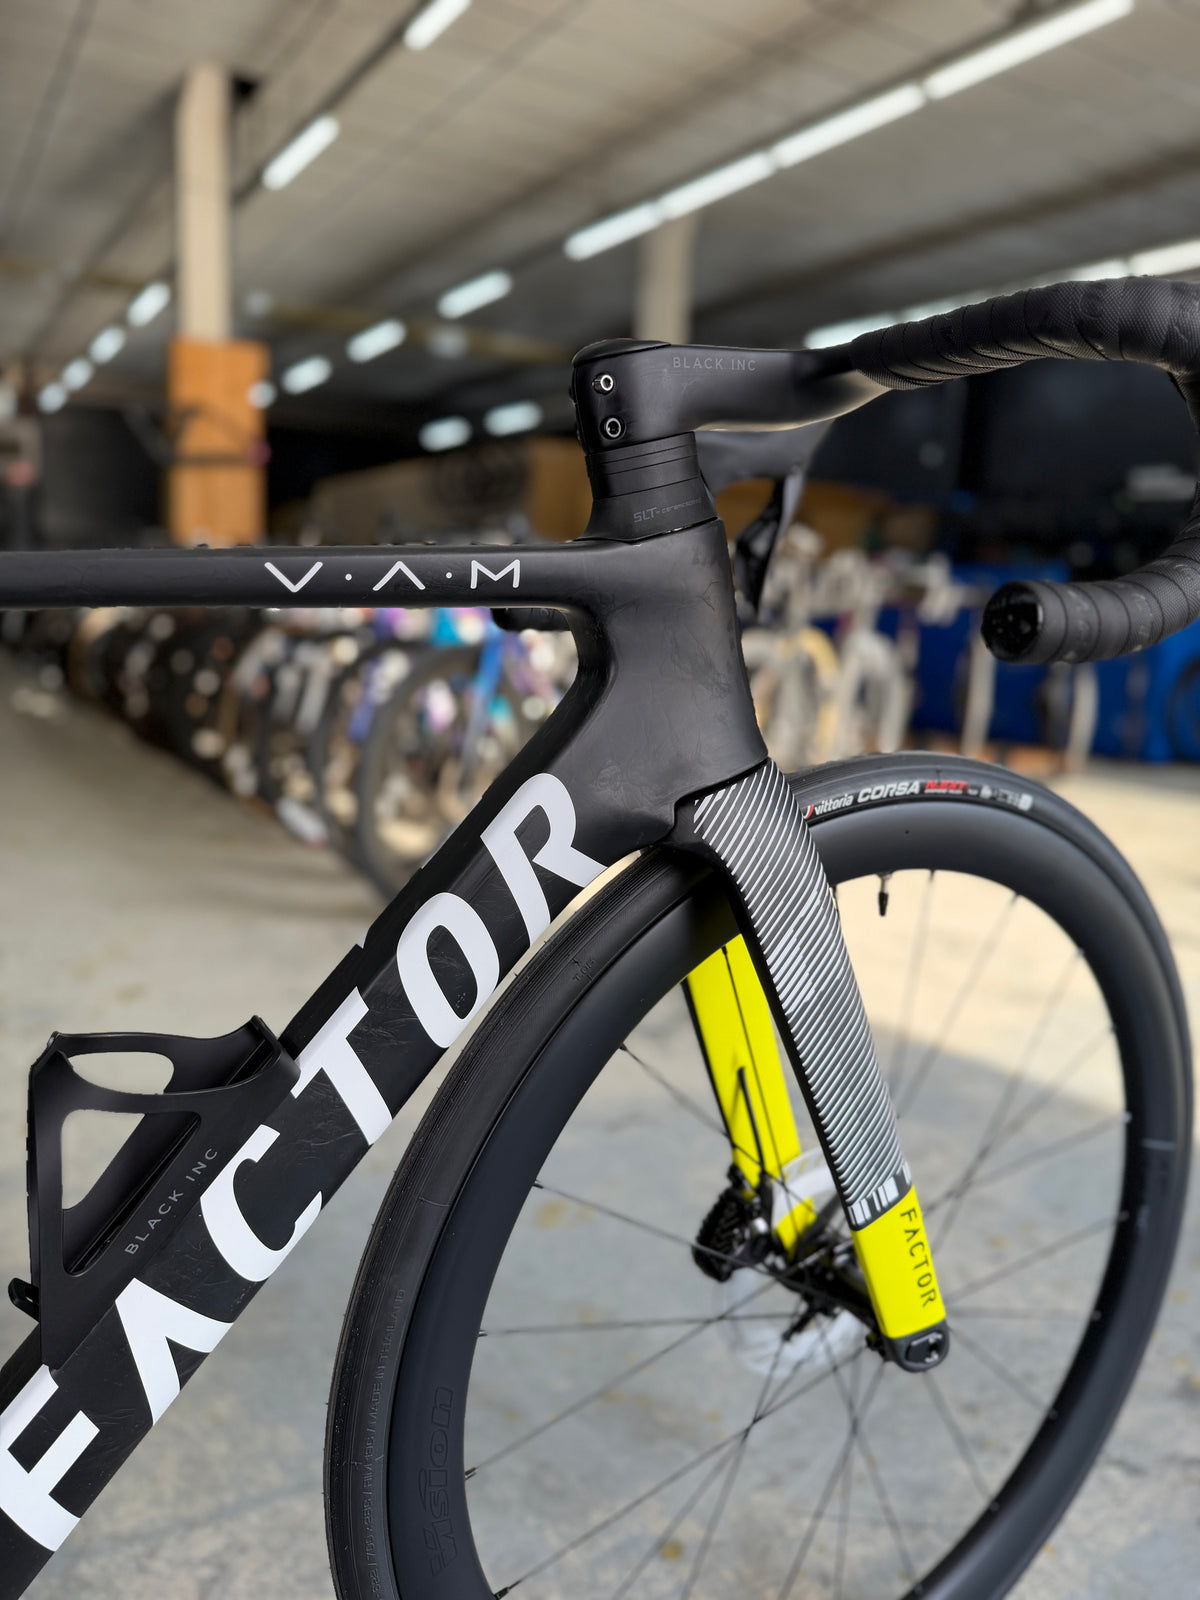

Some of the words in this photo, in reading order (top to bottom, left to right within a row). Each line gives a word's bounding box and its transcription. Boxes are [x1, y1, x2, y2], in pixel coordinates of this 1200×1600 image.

[672, 356, 724, 372] BLACK
[731, 359, 757, 372] INC
[814, 793, 853, 816] vittoria
[857, 780, 921, 804] CORSA
[0, 772, 606, 1552] FACTOR
[125, 1188, 184, 1255] BLACK
[185, 1148, 218, 1182] INC
[899, 1207, 937, 1308] FACTOR
[372, 1365, 387, 1380] IN
[367, 1382, 383, 1425] MADE
